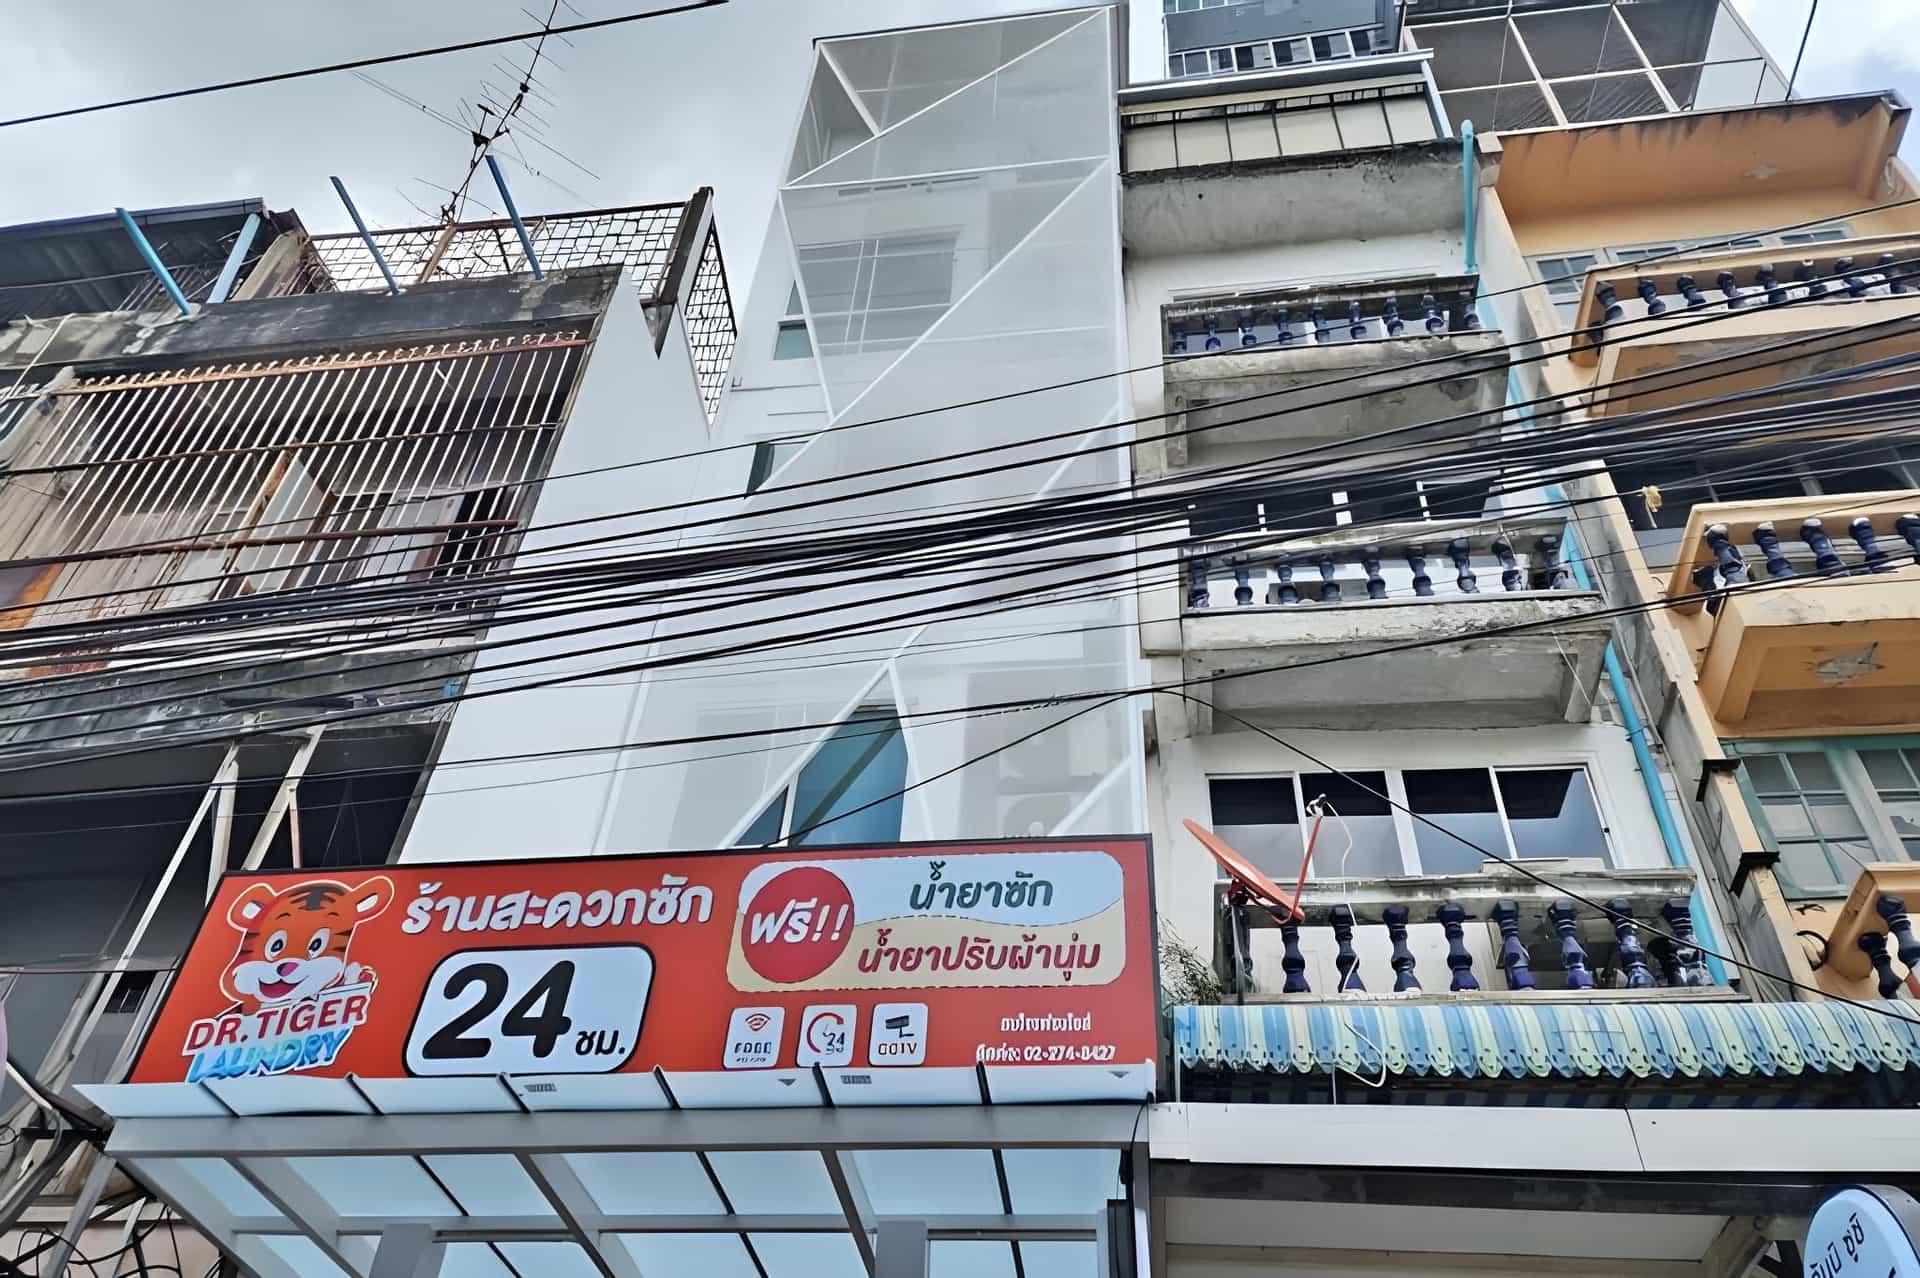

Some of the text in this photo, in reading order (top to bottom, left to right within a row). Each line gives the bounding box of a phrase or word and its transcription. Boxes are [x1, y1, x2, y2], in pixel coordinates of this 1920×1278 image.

[401, 873, 713, 934] ร้านสะดวกซัก
[910, 861, 1053, 910] น้ำยาซัก
[750, 897, 849, 944] ฟรี!!
[858, 928, 1101, 982] น้ำยาปรับผ้านุ่ม
[187, 995, 369, 1050] DR. TIGER
[422, 960, 625, 1059] 24 ชม.
[188, 1026, 351, 1083] LAUNDRY
